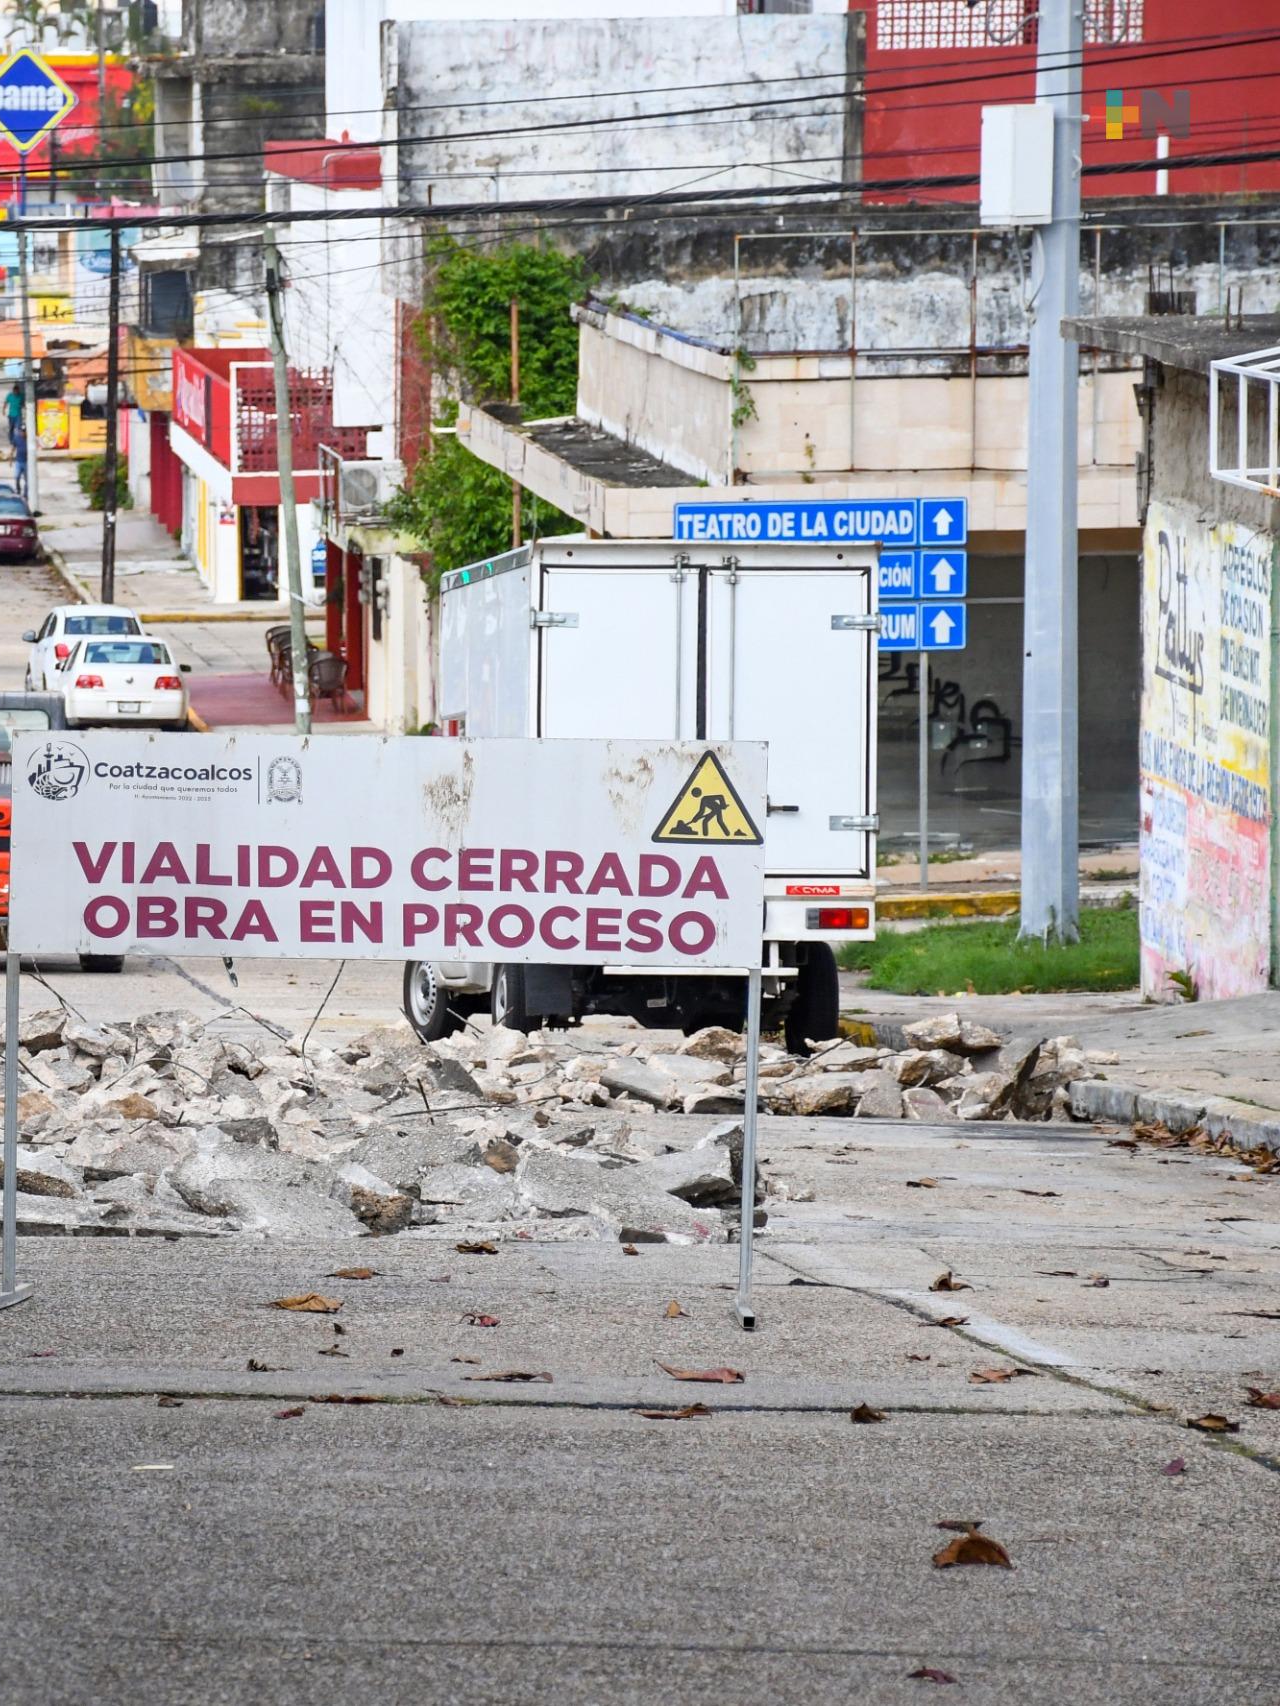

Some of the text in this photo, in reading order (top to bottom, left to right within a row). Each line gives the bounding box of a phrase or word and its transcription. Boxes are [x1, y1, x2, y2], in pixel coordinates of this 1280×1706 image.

[678, 510, 913, 540] TEATRO DE LA CIUDAD
[94, 761, 253, 781] Coatzacoalcos
[109, 782, 121, 790] Por
[123, 782, 130, 790] la
[160, 785, 175, 793] que
[217, 785, 238, 793] todos
[72, 841, 730, 900] VIALIDAD CERRADA
[802, 886, 836, 894] CYMA
[83, 894, 718, 956] OBRA EN PROCESO
